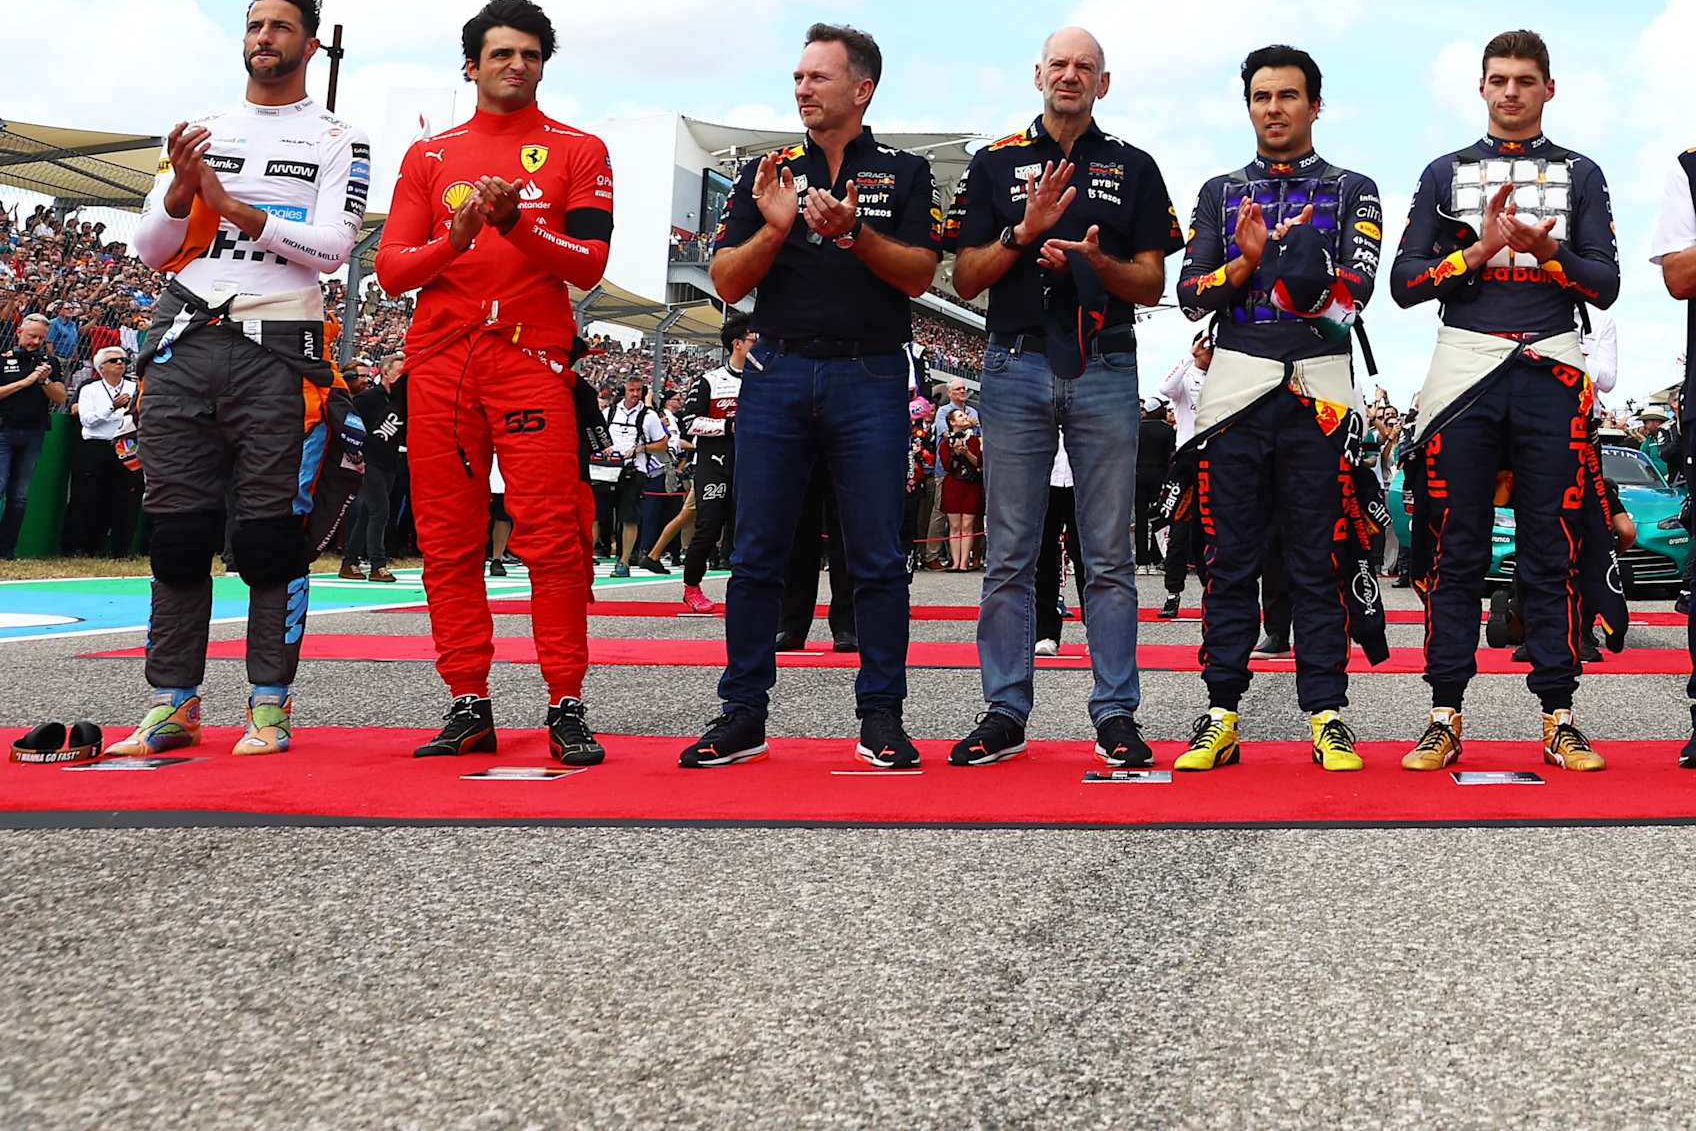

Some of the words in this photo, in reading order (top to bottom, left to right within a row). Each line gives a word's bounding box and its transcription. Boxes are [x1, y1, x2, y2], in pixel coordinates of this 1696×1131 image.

[202, 156, 240, 170] plunk>
[269, 163, 315, 178] ARROW
[857, 171, 895, 179] ORACLE
[1091, 179, 1120, 192] BYBIT
[516, 201, 551, 209] antander
[858, 191, 889, 204] BYBIT
[1098, 191, 1122, 206] Tezos
[863, 207, 892, 218] Tezos
[532, 225, 556, 244] MILLE
[282, 237, 317, 256] RICHARD
[318, 252, 340, 261] MILLE
[556, 238, 589, 255] RICHARD
[1481, 267, 1509, 283] ed
[504, 409, 545, 433] 55
[1602, 449, 1639, 461] RTIN
[703, 483, 726, 500] 24
[1593, 473, 1606, 497] YOU
[1491, 535, 1511, 544] ramco
[1669, 536, 1689, 546] aramco
[1358, 559, 1371, 587] Hard
[1364, 586, 1377, 616] Rock
[21, 753, 43, 762] WANNA
[45, 753, 56, 762] GO
